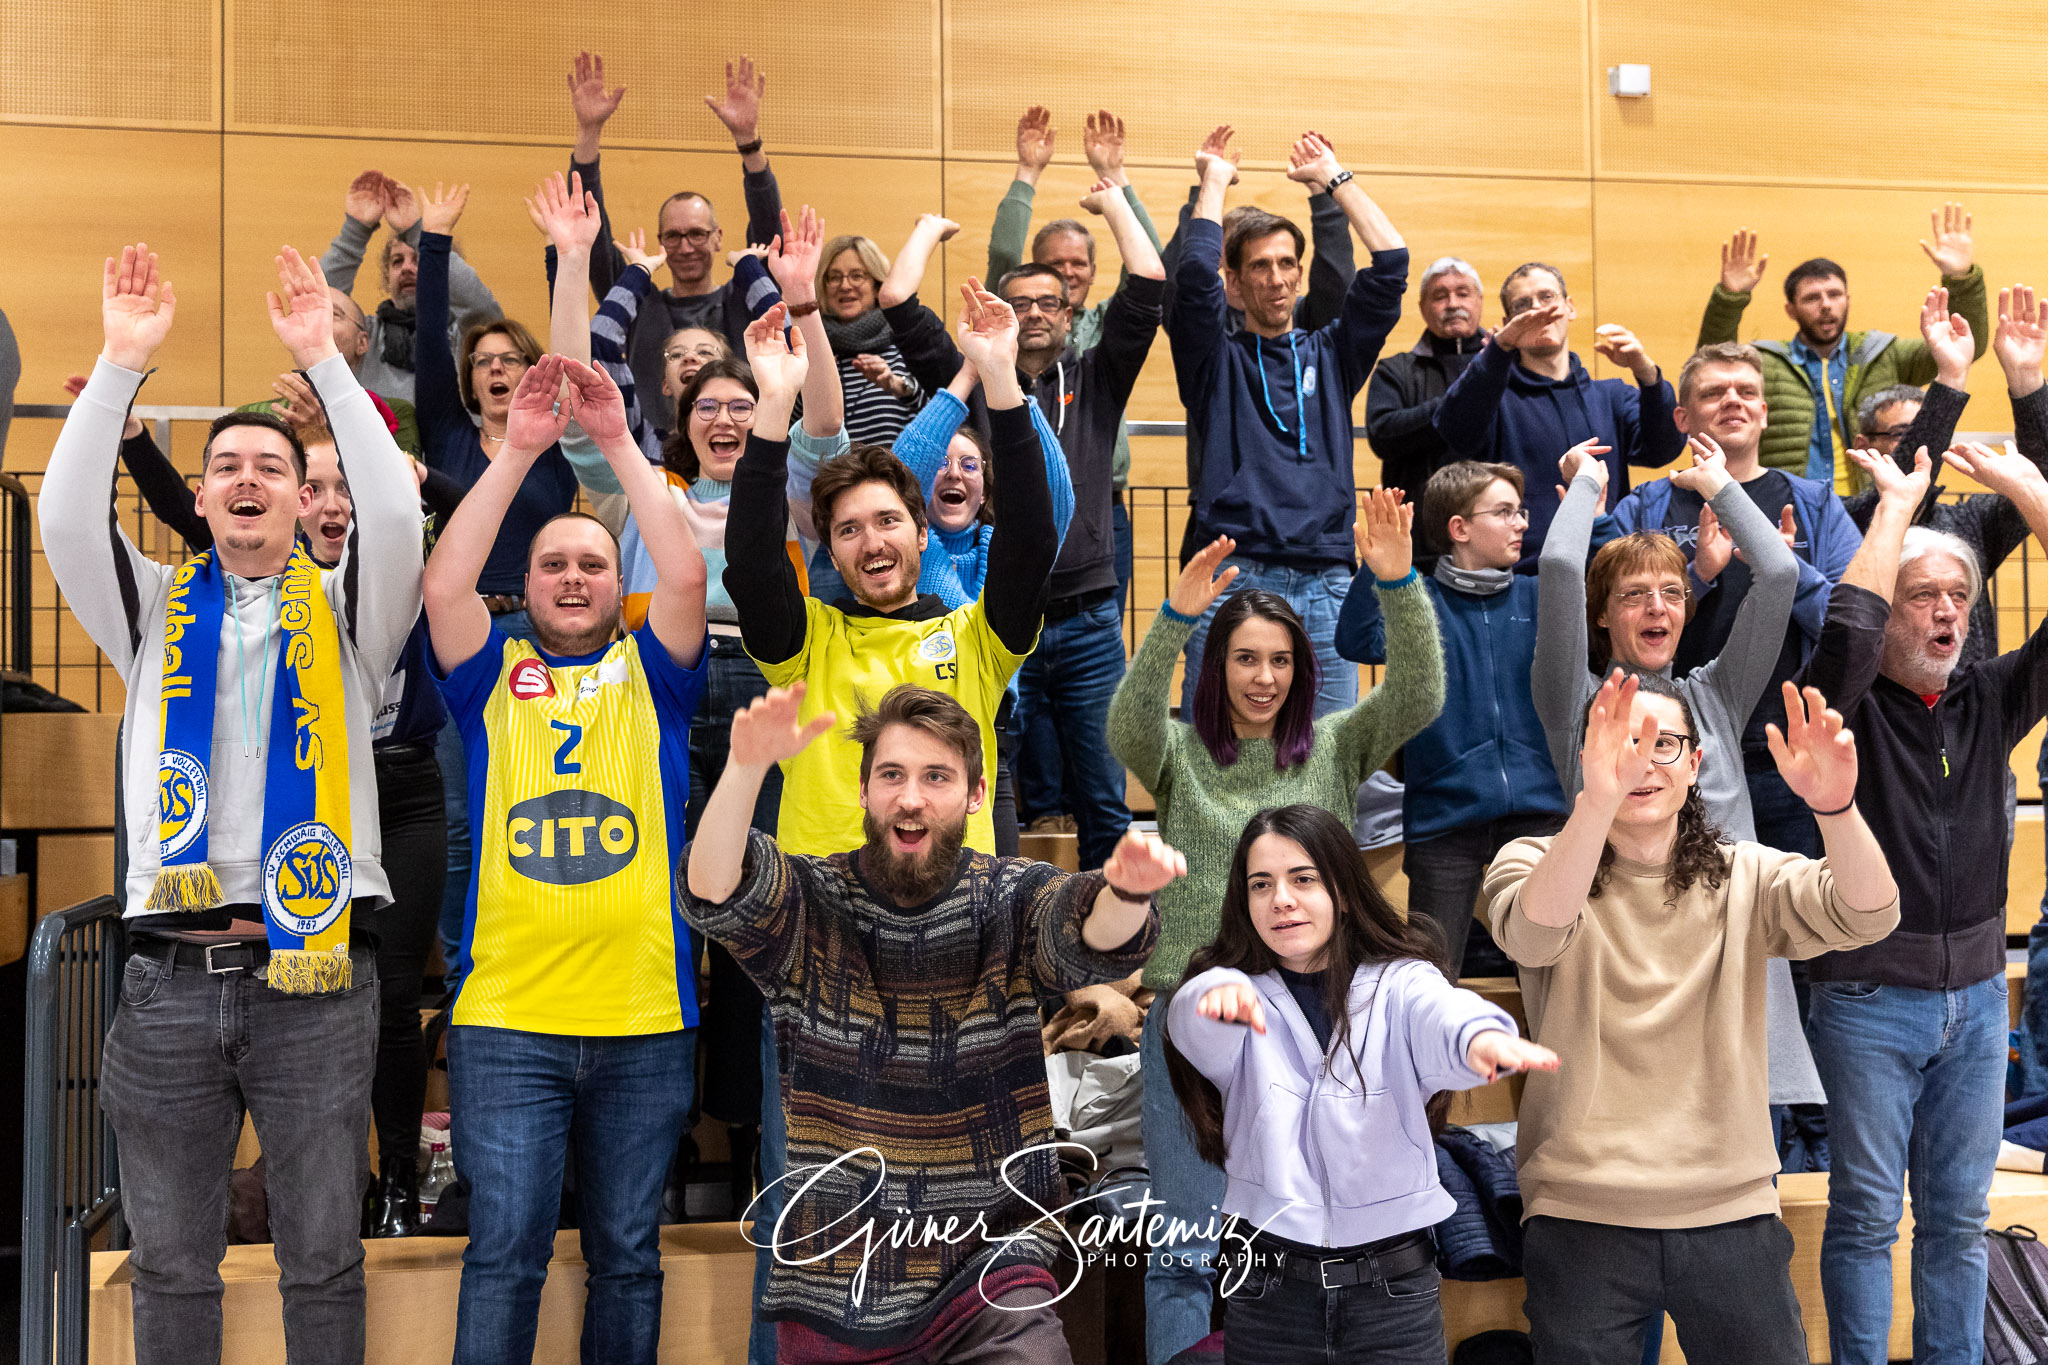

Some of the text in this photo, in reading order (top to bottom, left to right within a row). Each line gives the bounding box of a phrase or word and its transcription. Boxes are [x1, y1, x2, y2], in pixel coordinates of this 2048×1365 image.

[935, 663, 956, 680] CS
[508, 815, 635, 858] CITO
[275, 828, 316, 861] SCHWAIG
[321, 829, 349, 880] VOLLEYBALL
[296, 920, 317, 930] 1967
